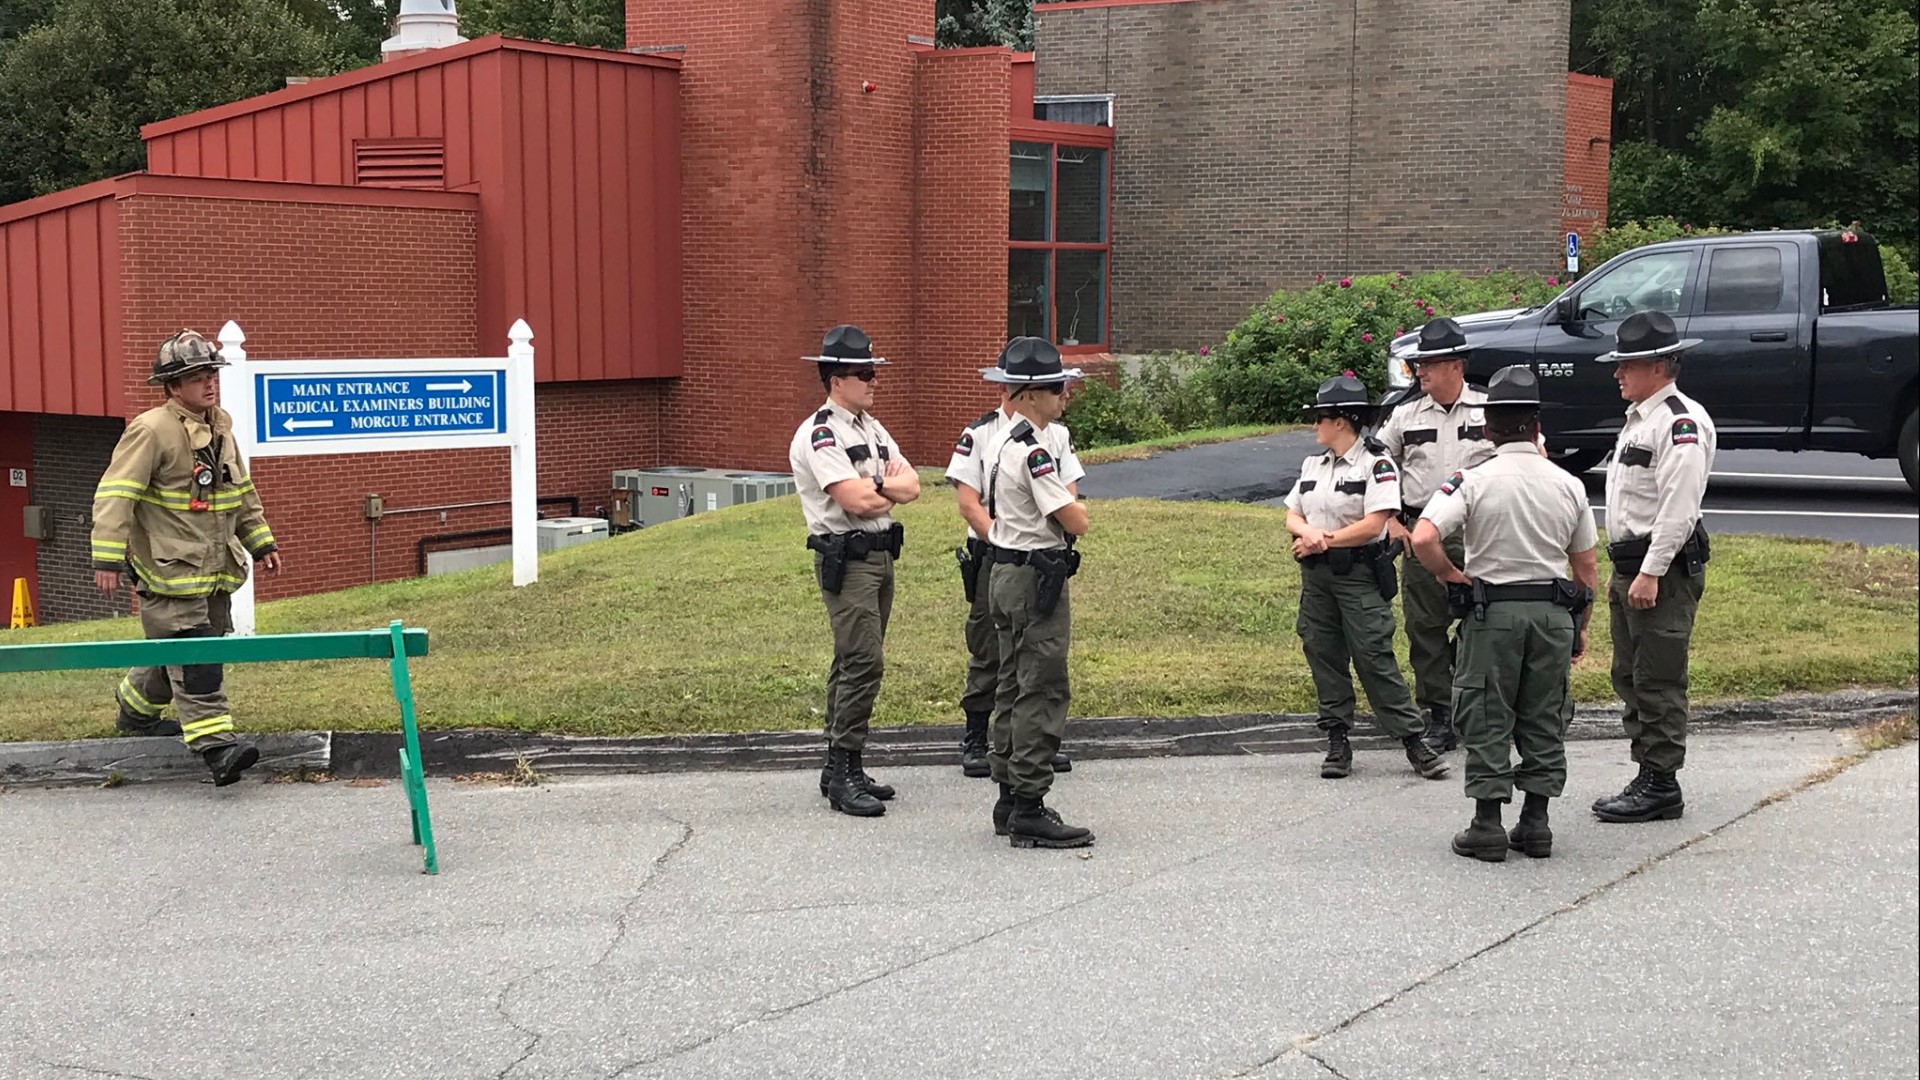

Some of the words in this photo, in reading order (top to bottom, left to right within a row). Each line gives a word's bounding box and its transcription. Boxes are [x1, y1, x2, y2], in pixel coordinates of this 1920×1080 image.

[1538, 369, 1574, 377] 1500
[292, 383, 331, 397] MAIN
[337, 382, 410, 395] ENTRANCE
[273, 400, 338, 414] MEDICAL
[343, 398, 423, 412] EXAMINERS
[428, 396, 491, 410] BUILDING
[350, 415, 409, 429] MORGUE
[414, 413, 484, 427] ENTRANCE
[12, 470, 24, 481] D2
